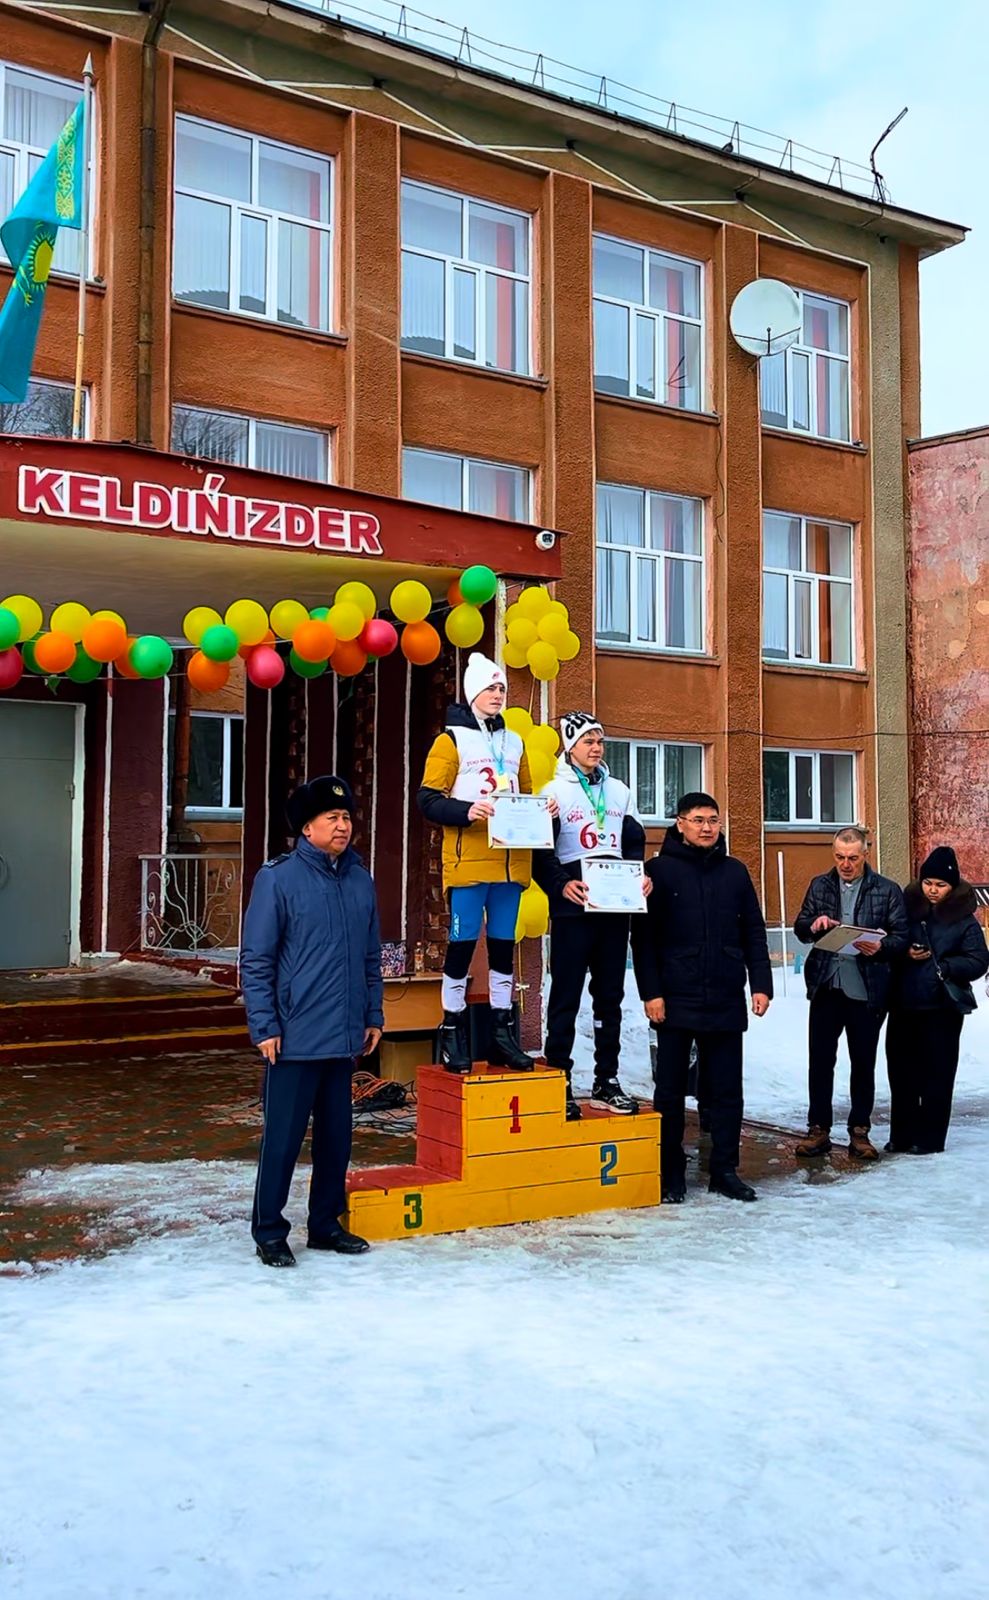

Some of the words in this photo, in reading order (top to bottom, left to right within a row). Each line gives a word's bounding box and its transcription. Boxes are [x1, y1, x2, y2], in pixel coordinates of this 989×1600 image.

[479, 766, 497, 794] 3
[580, 821, 598, 849] 6
[609, 833, 618, 848] 2
[508, 1096, 521, 1133] 1
[600, 1144, 618, 1186] 2
[404, 1193, 422, 1230] 3
